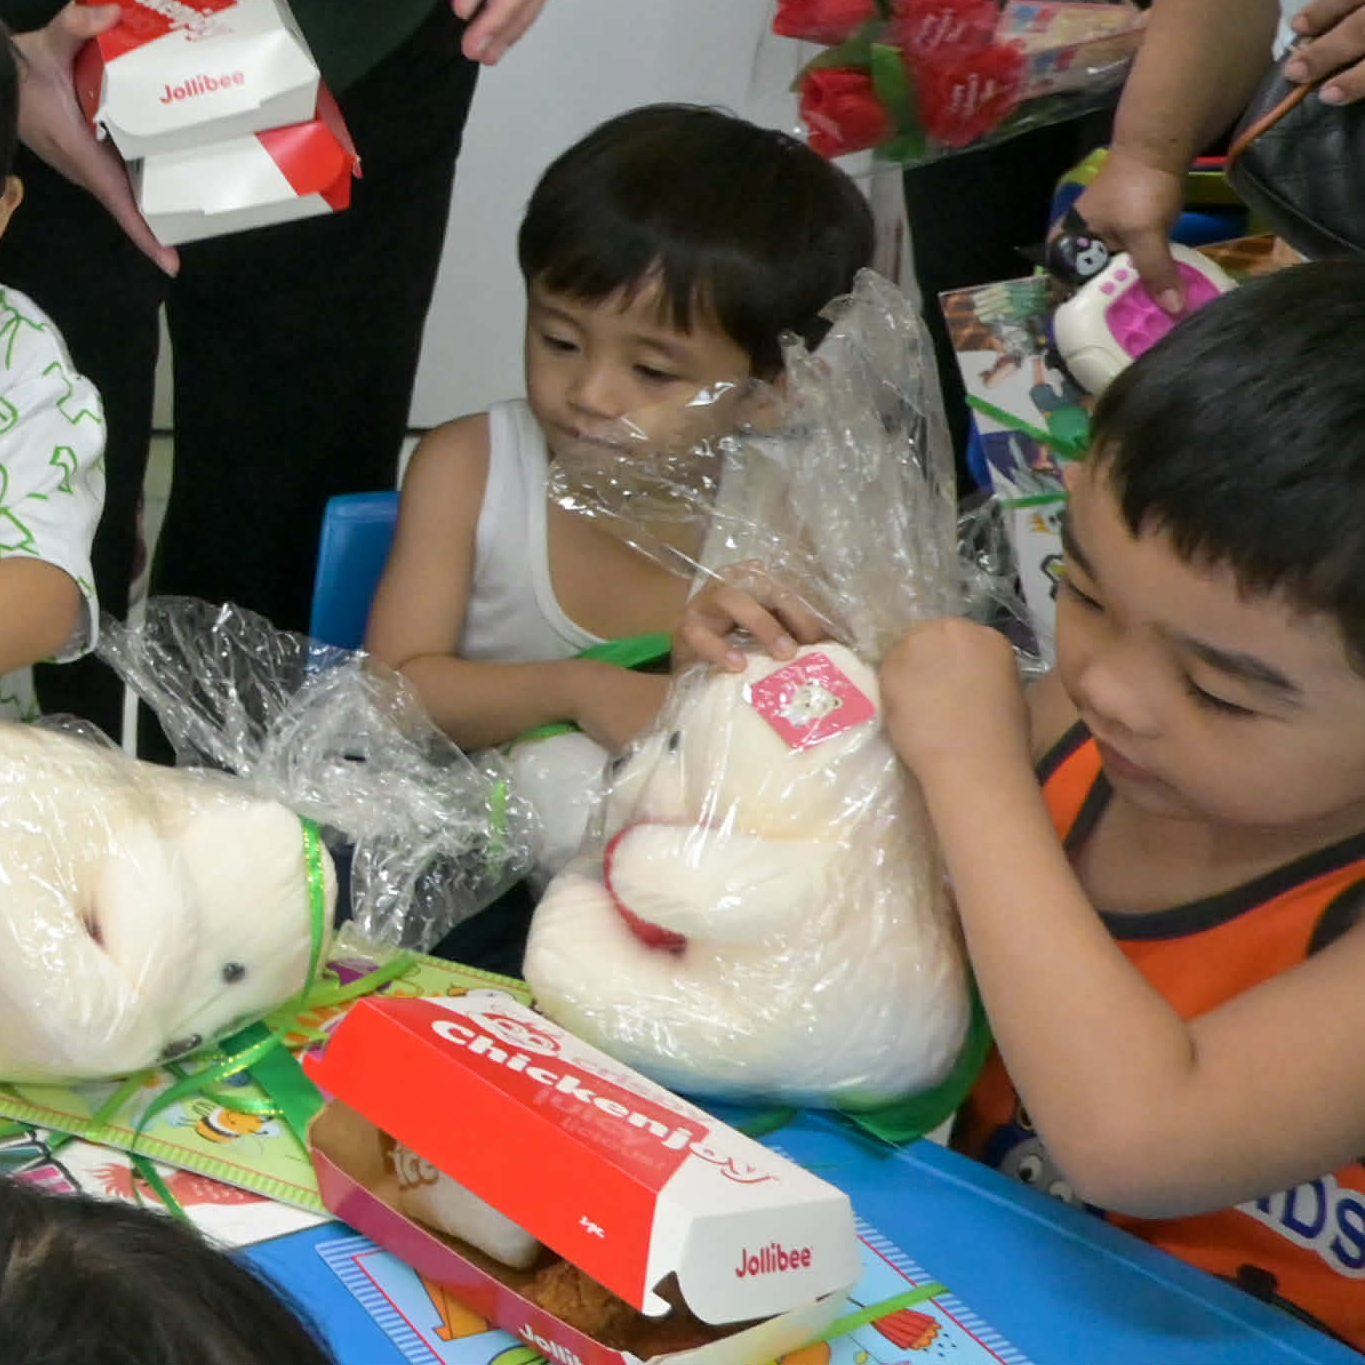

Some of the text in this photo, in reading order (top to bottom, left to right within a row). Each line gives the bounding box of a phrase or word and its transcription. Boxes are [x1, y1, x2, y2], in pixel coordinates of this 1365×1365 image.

[160, 70, 245, 105] Jollibee
[432, 1020, 777, 1184] Chickenjoy
[735, 1243, 812, 1278] Jollibee
